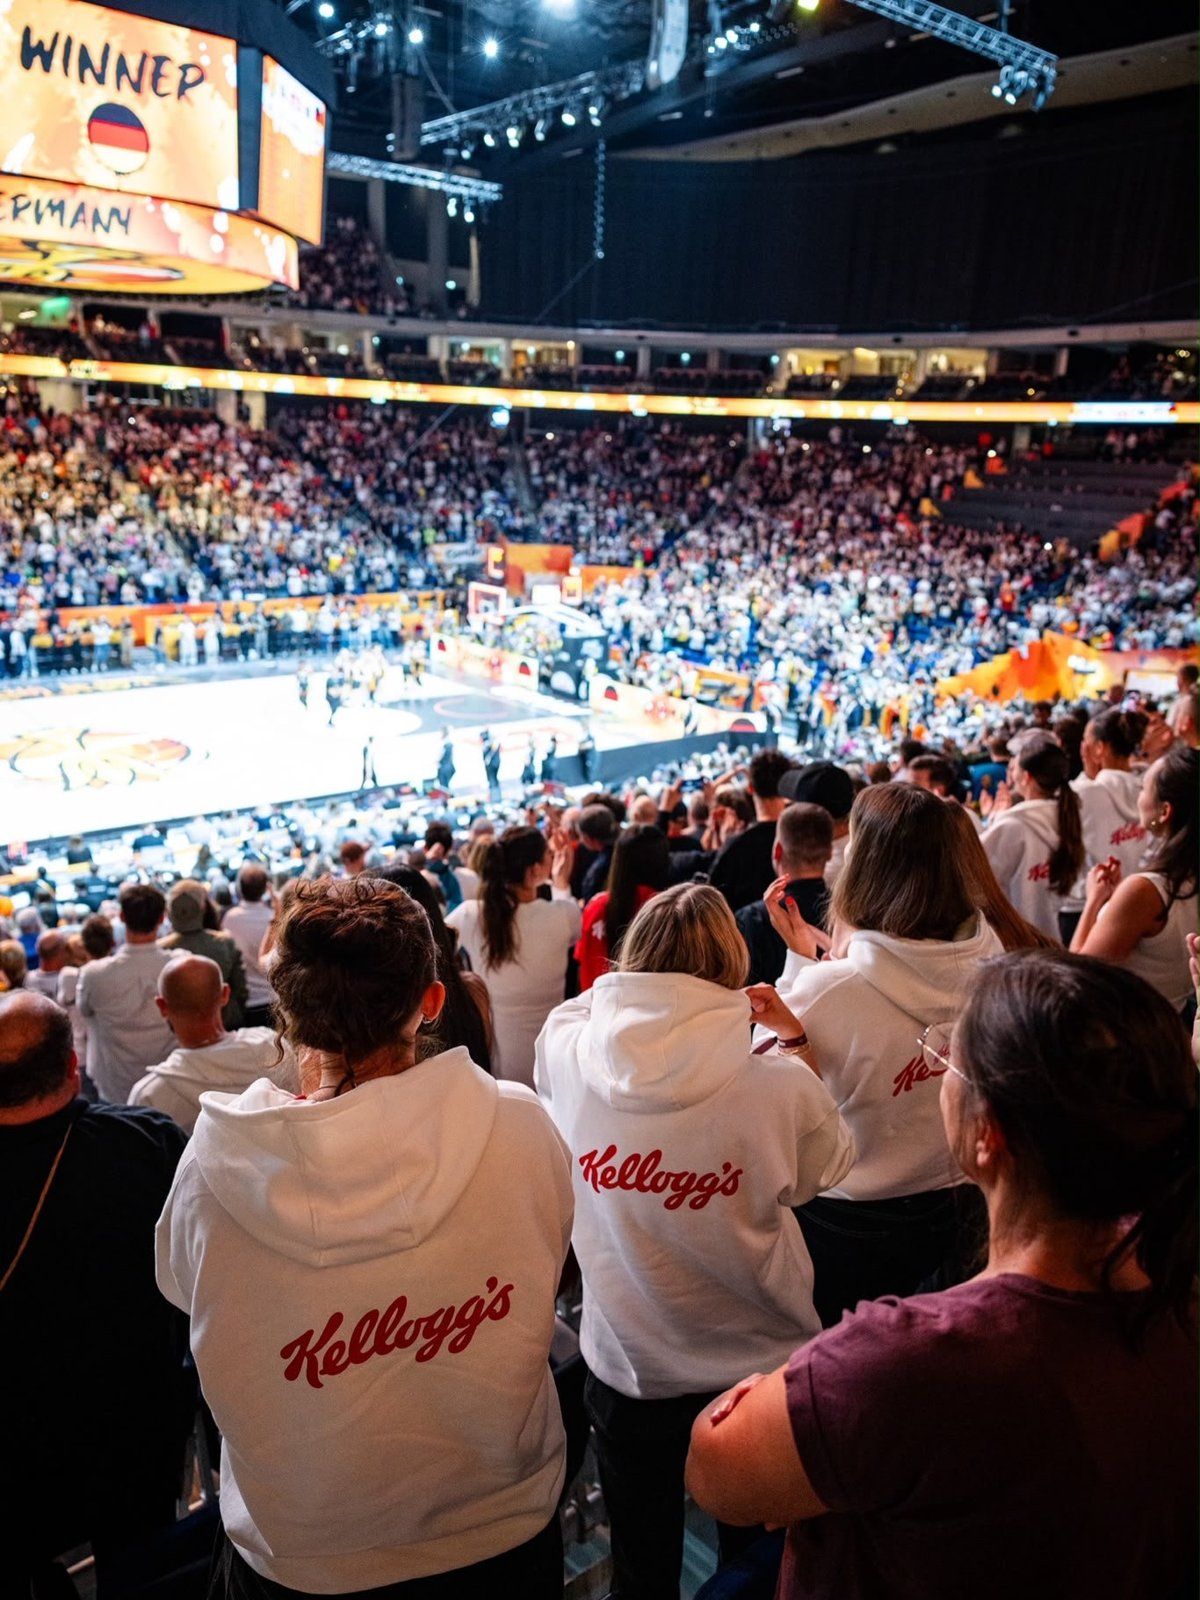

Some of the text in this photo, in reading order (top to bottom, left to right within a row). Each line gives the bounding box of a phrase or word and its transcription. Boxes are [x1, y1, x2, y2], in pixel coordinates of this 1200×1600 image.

[0, 191, 131, 235] RMANY
[579, 1144, 743, 1210] Kellogg's
[280, 1276, 514, 1389] Kellogg's
